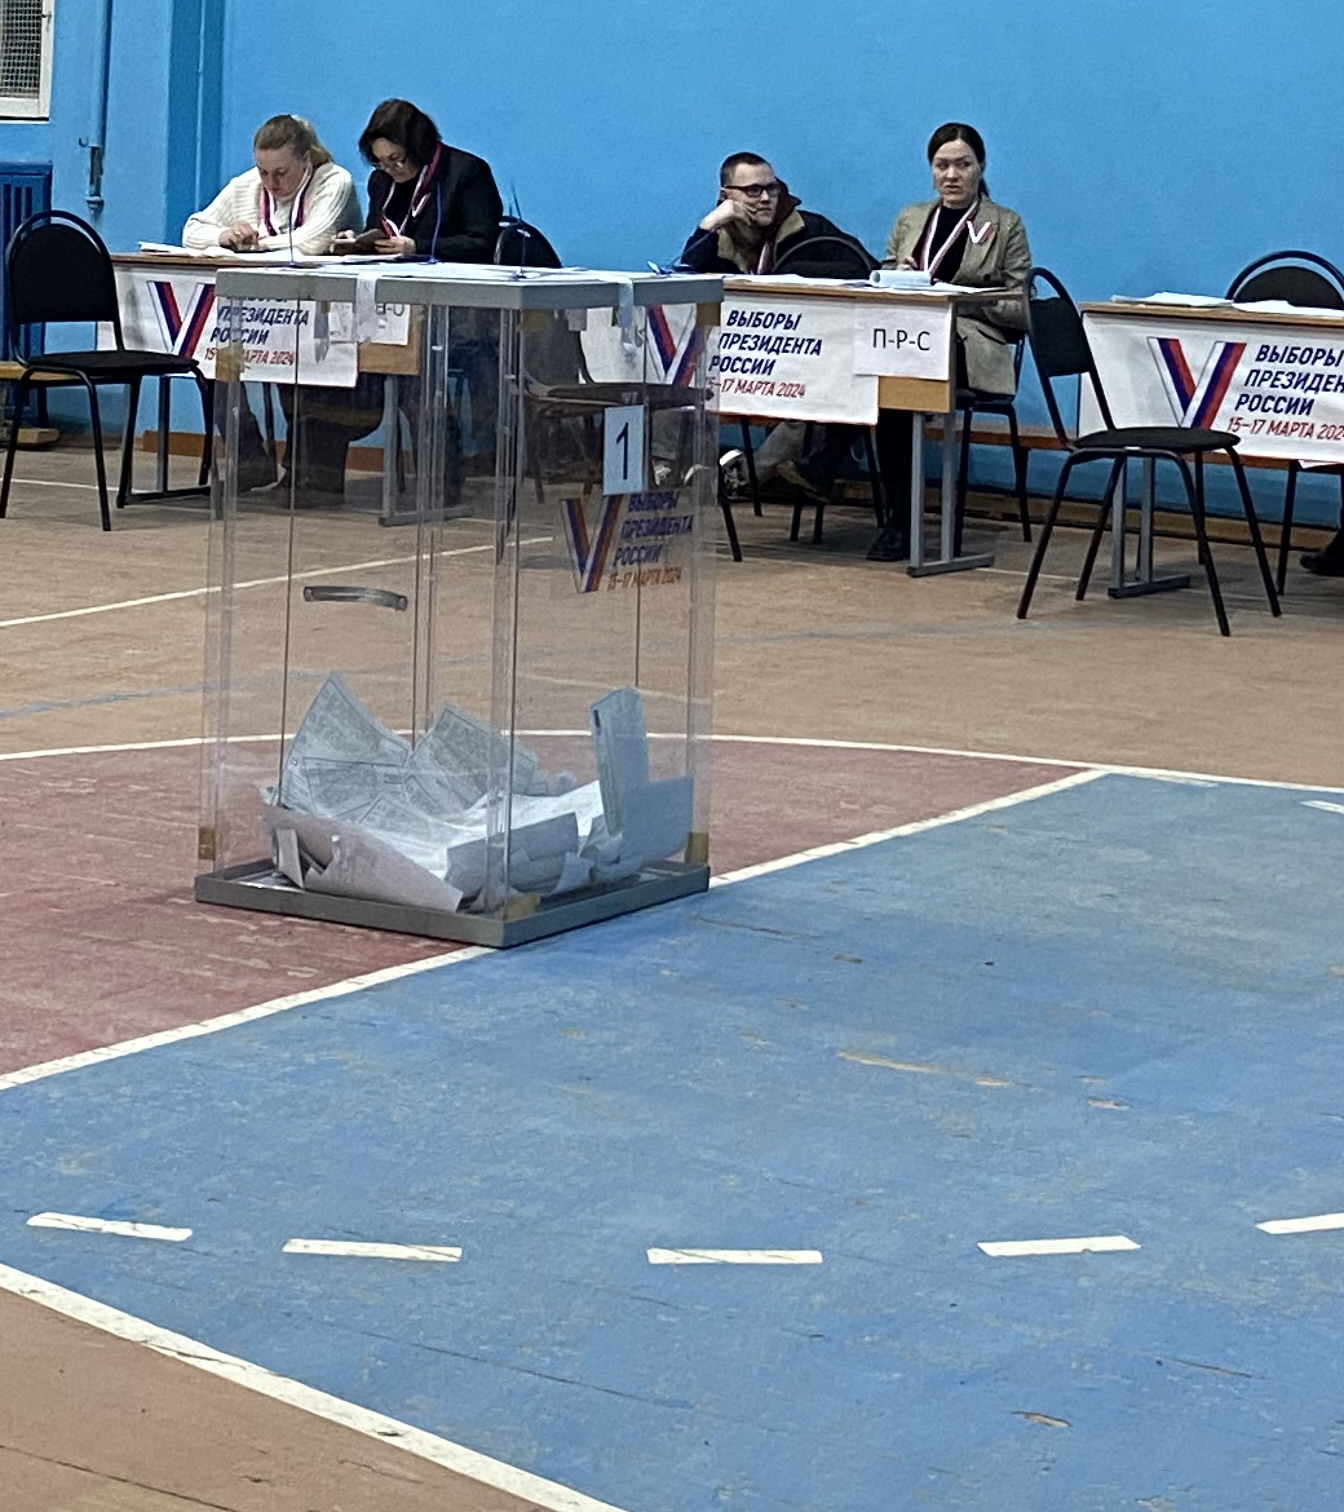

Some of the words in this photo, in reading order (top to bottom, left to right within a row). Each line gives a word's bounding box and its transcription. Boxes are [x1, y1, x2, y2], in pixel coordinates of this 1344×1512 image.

[726, 310, 802, 331] ВЫБОРЫ
[718, 332, 822, 356] ПРЕЗИДЕНТА
[872, 328, 931, 351] П-Р-С
[244, 349, 270, 364] АРТА
[708, 355, 776, 376] РОССИИ
[1255, 344, 1344, 367] ВЫБОРЫ
[735, 378, 774, 395] МАРТА
[776, 381, 806, 398] 2024
[1235, 393, 1314, 416] РОССИИ
[1267, 419, 1314, 438] МАРТА
[616, 422, 629, 481] 1
[628, 490, 680, 512] ВЫБОРЫ
[620, 515, 694, 540] ПРЕЗИДЕНТА
[613, 544, 662, 567] РОССИИ
